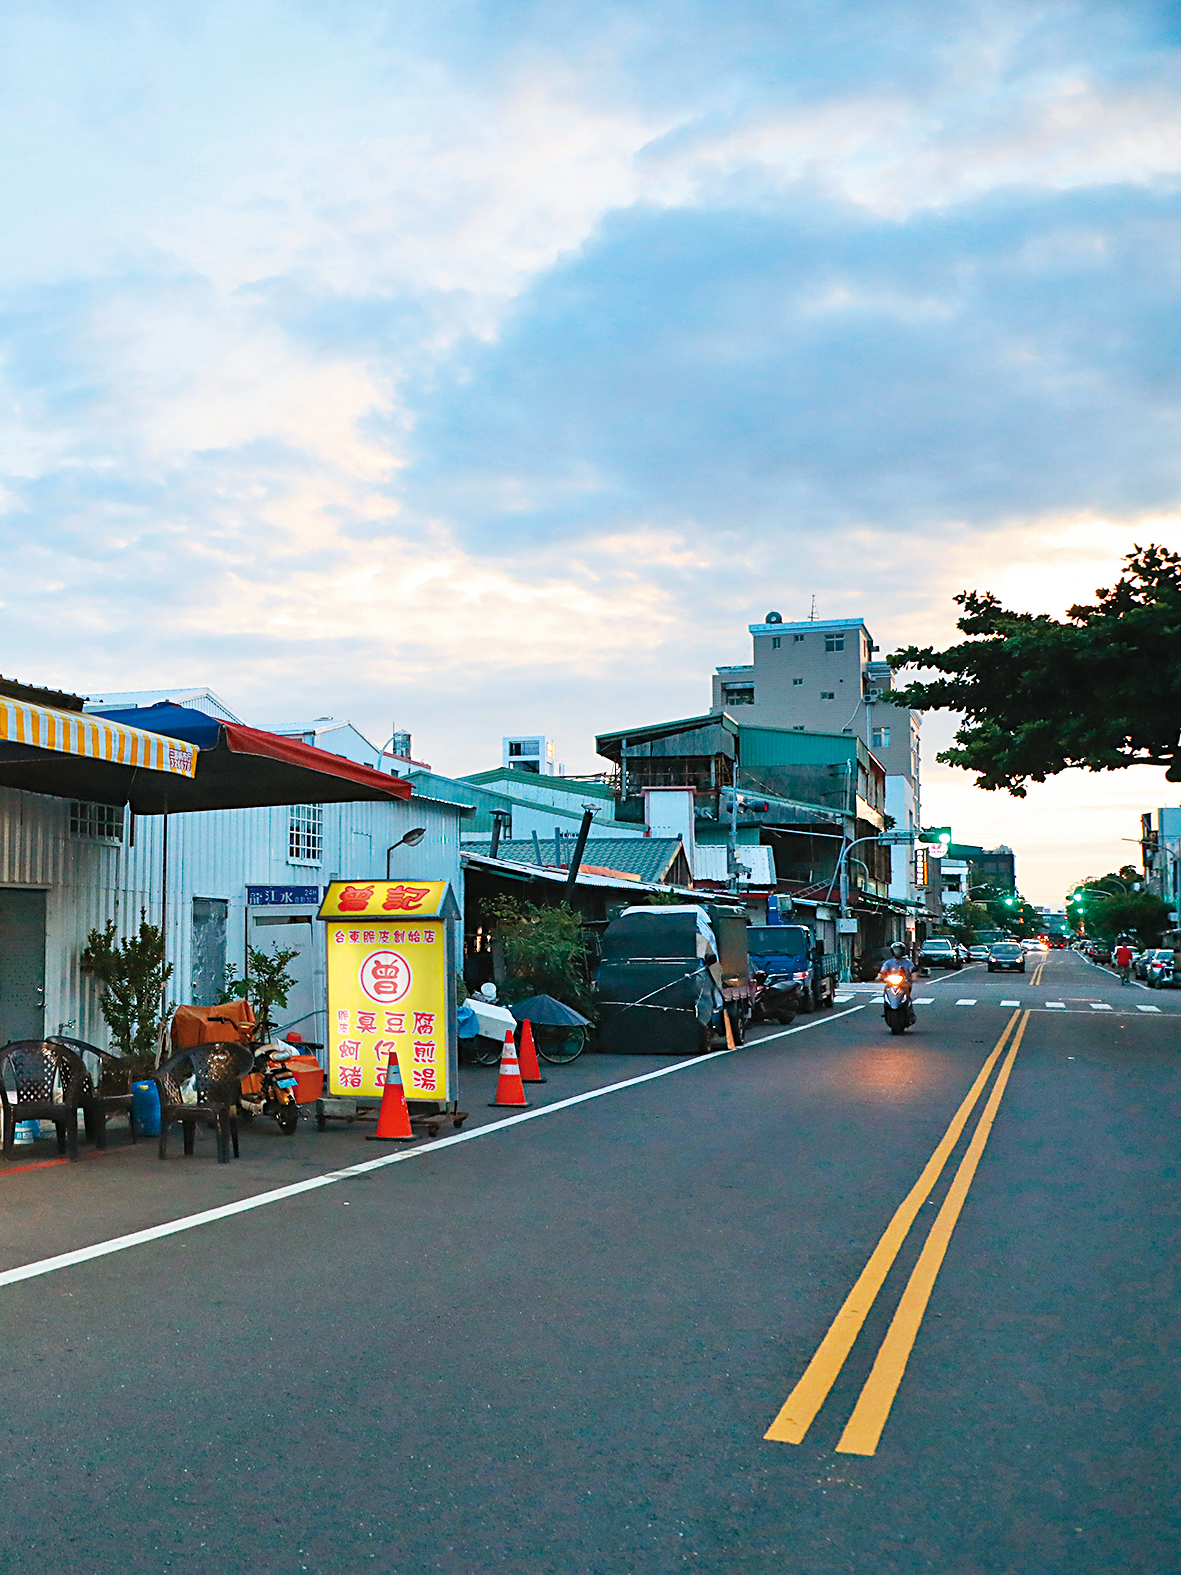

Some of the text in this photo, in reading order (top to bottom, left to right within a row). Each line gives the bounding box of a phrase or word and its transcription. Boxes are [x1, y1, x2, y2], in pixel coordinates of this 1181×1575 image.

[338, 885, 430, 912] 曾記
[334, 930, 436, 944] 台東脆皮創始店
[372, 959, 400, 995] 曾
[338, 1009, 350, 1034] 脆皮
[356, 1011, 435, 1035] 臭豆腐
[339, 1040, 436, 1063] 蚵仔煎
